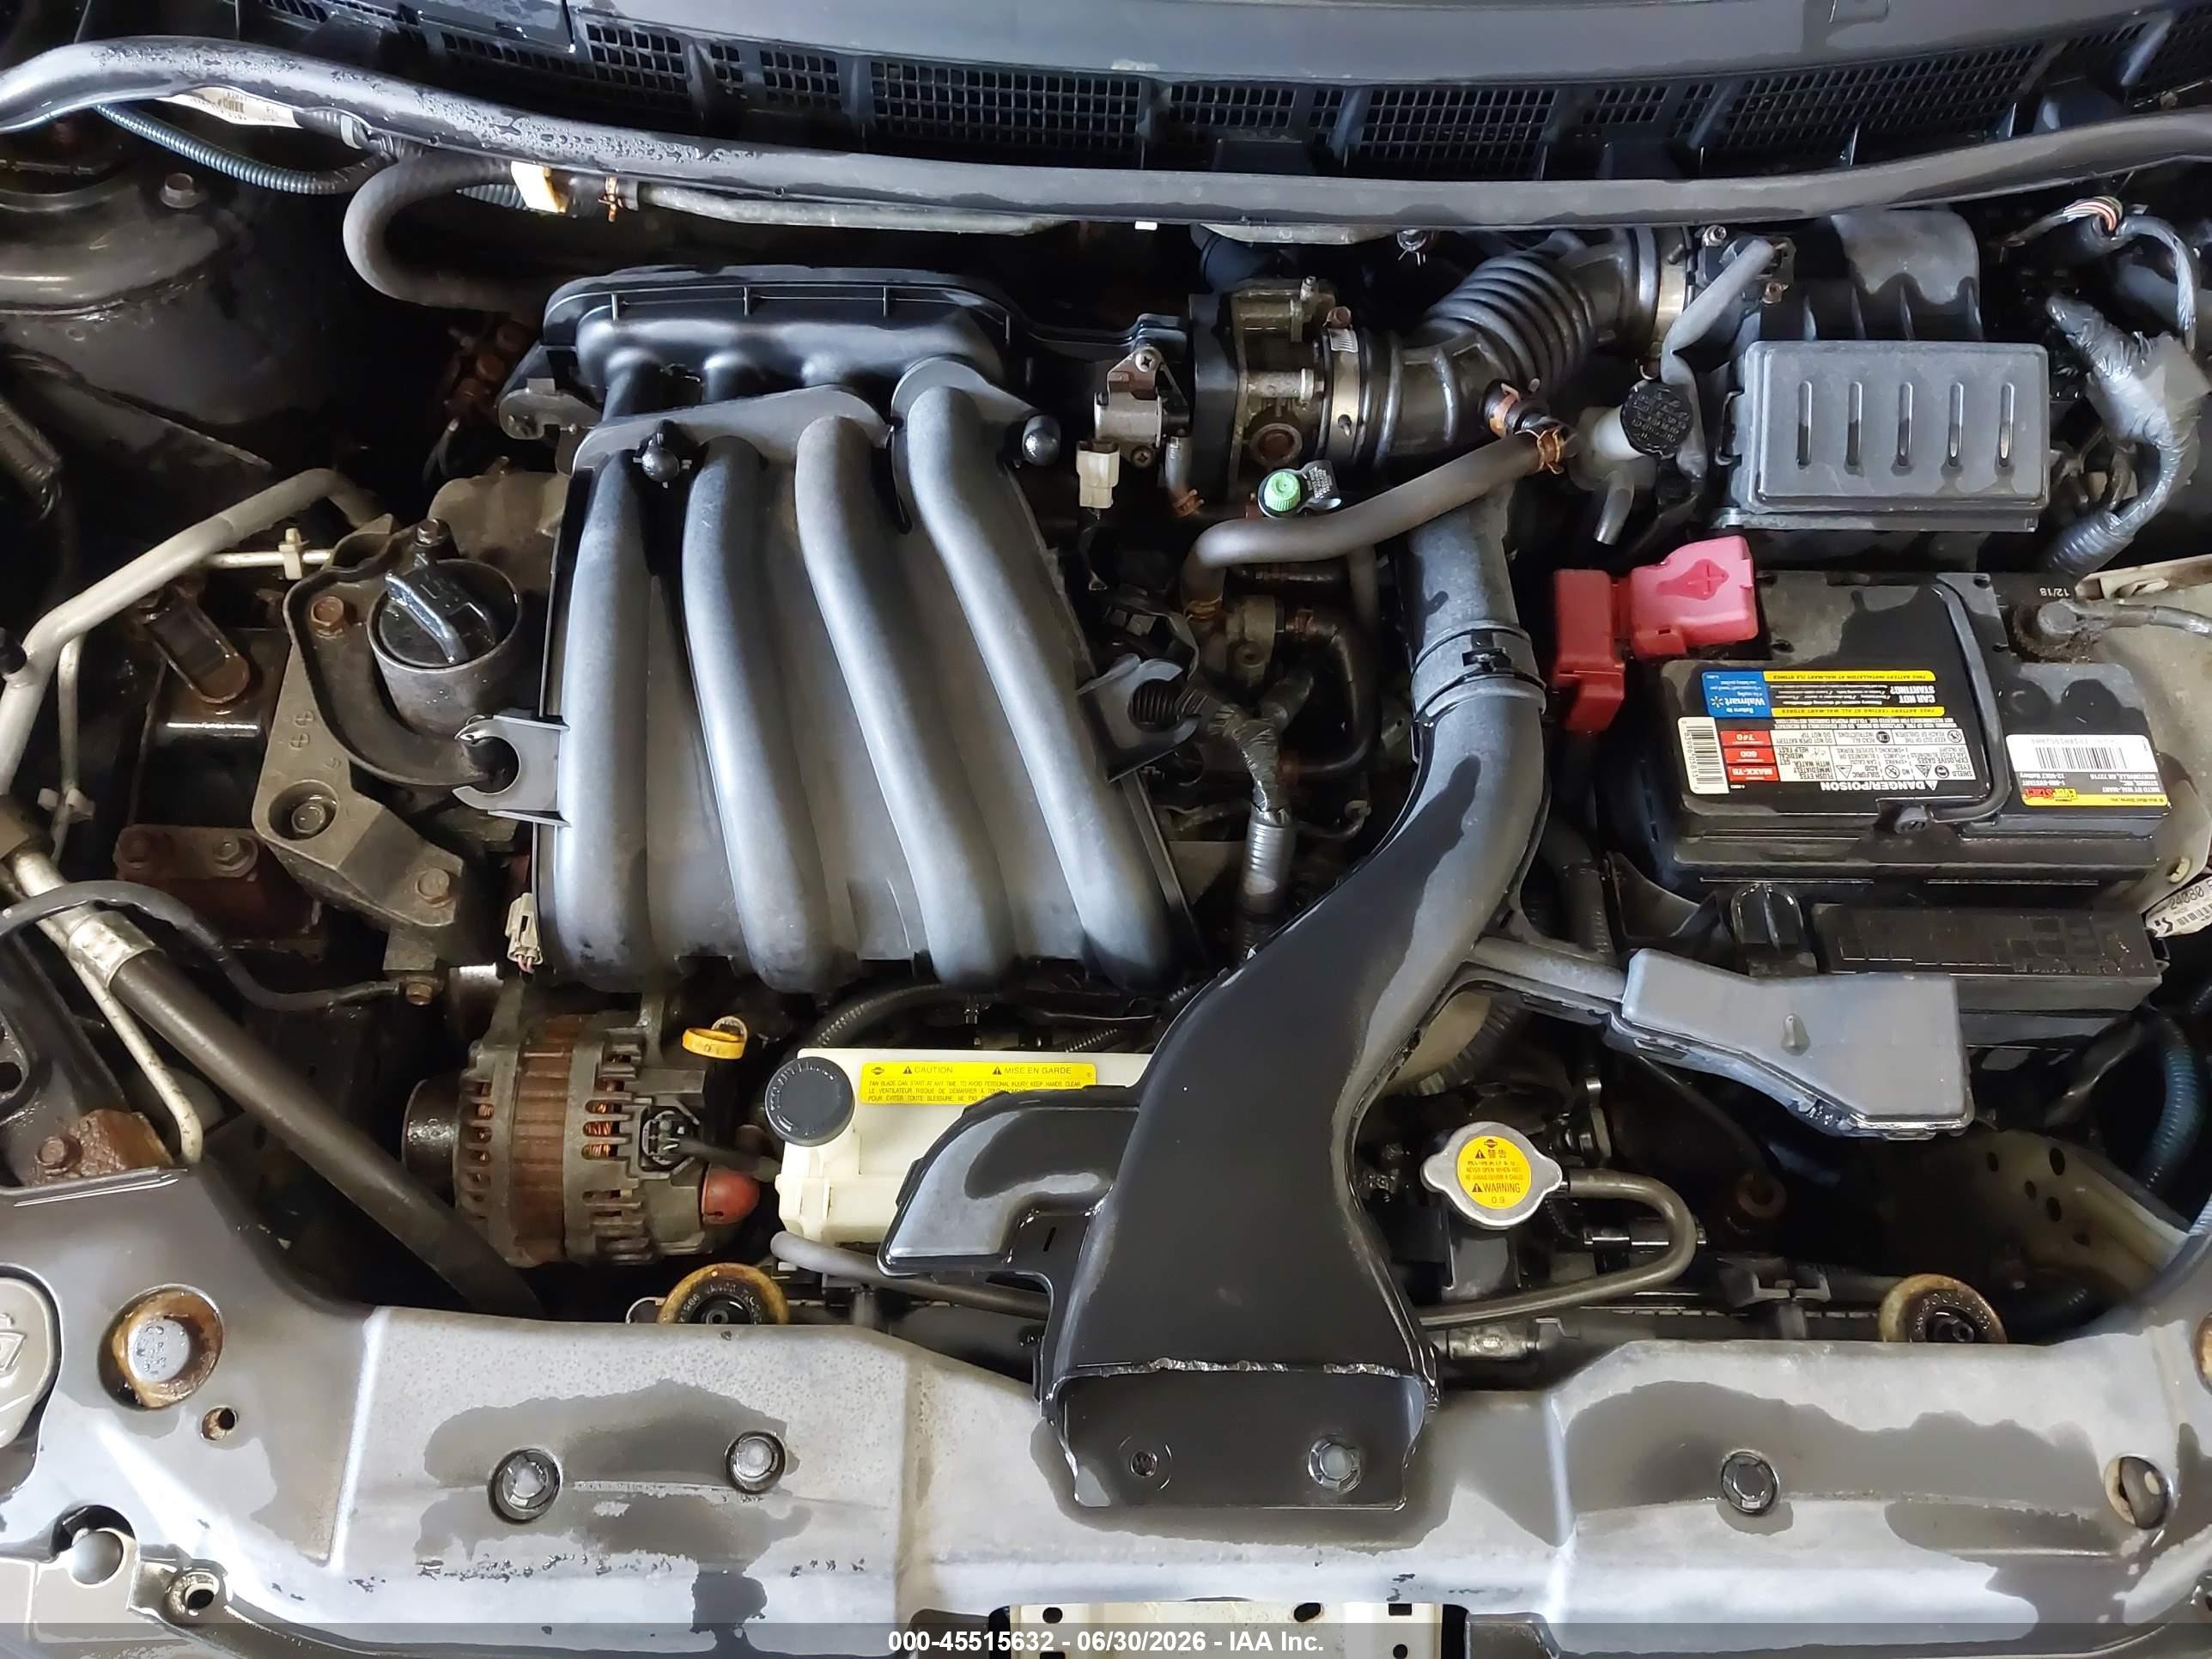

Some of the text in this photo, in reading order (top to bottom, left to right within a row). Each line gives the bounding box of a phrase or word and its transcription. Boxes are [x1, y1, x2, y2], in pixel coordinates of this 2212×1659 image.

[2039, 587, 2069, 598] 12/18
[1890, 685, 1936, 695] STARTING?
[1724, 697, 1765, 706] Walmart
[1899, 695, 1917, 703] NOT
[1917, 695, 1936, 703] CAR
[1820, 781, 1925, 790] DANGER/POISON
[2025, 788, 2077, 799] EverStart
[2169, 885, 2204, 910] 24080
[1483, 1183, 1520, 1193] WARNING
